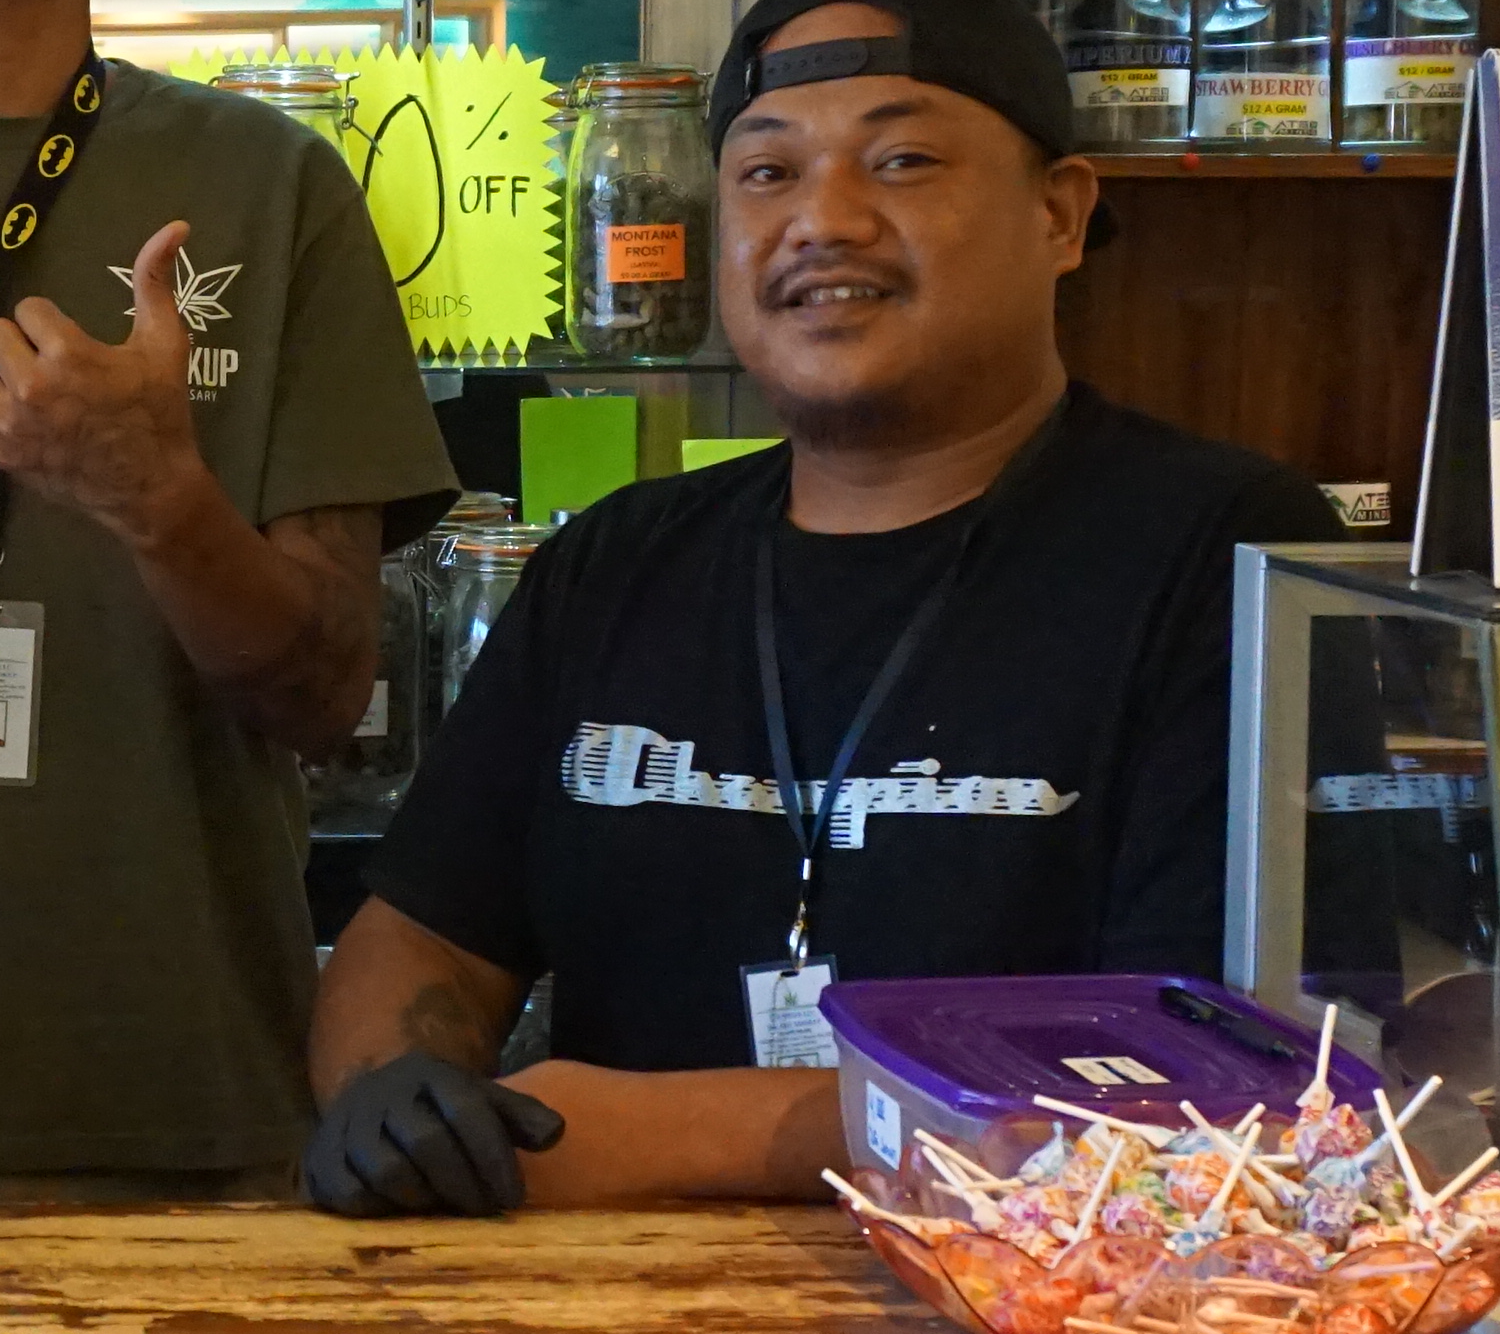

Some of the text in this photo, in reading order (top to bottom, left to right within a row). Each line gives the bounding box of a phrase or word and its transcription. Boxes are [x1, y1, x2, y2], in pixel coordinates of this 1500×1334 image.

[1127, 72, 1158, 82] GRAM
[1195, 78, 1312, 98] STRAWBERRY
[1242, 104, 1307, 115] $12 A GRAM
[459, 175, 531, 218] OFF
[611, 230, 679, 241] MONTANA
[625, 245, 667, 257] FROST
[408, 293, 473, 321] BUDS
